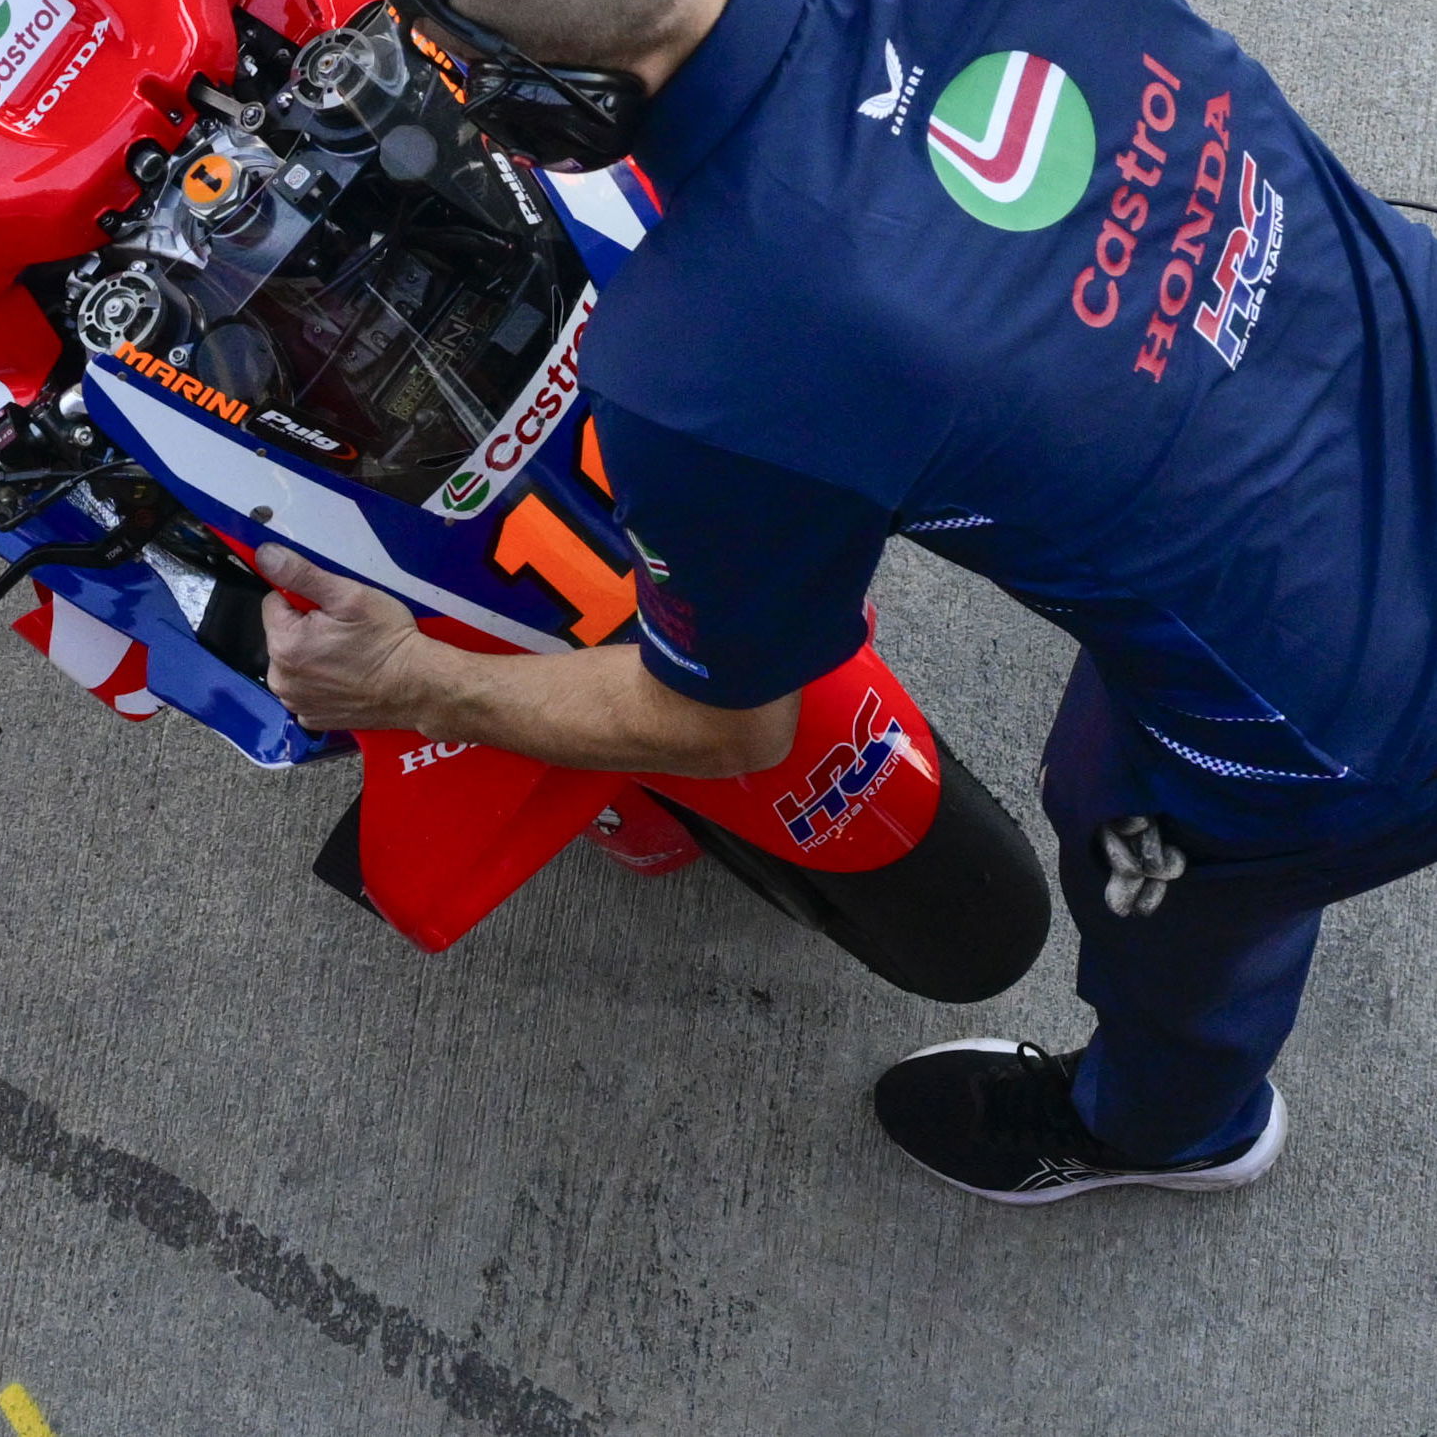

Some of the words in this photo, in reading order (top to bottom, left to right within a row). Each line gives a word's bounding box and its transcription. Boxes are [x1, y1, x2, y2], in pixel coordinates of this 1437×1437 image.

[14, 16, 111, 133] HONDA
[890, 65, 924, 136] CASTORE
[491, 152, 541, 226] Puig
[1072, 52, 1181, 329] Castrol
[1134, 91, 1232, 384] HONDA
[1193, 150, 1276, 371] HRC
[1262, 192, 1284, 286] RACING
[114, 341, 251, 425] MARINI
[261, 409, 341, 451] Puig
[484, 300, 594, 472] Castr
[398, 741, 480, 775] HO
[772, 686, 903, 846] HRC
[801, 802, 863, 853] Honda
